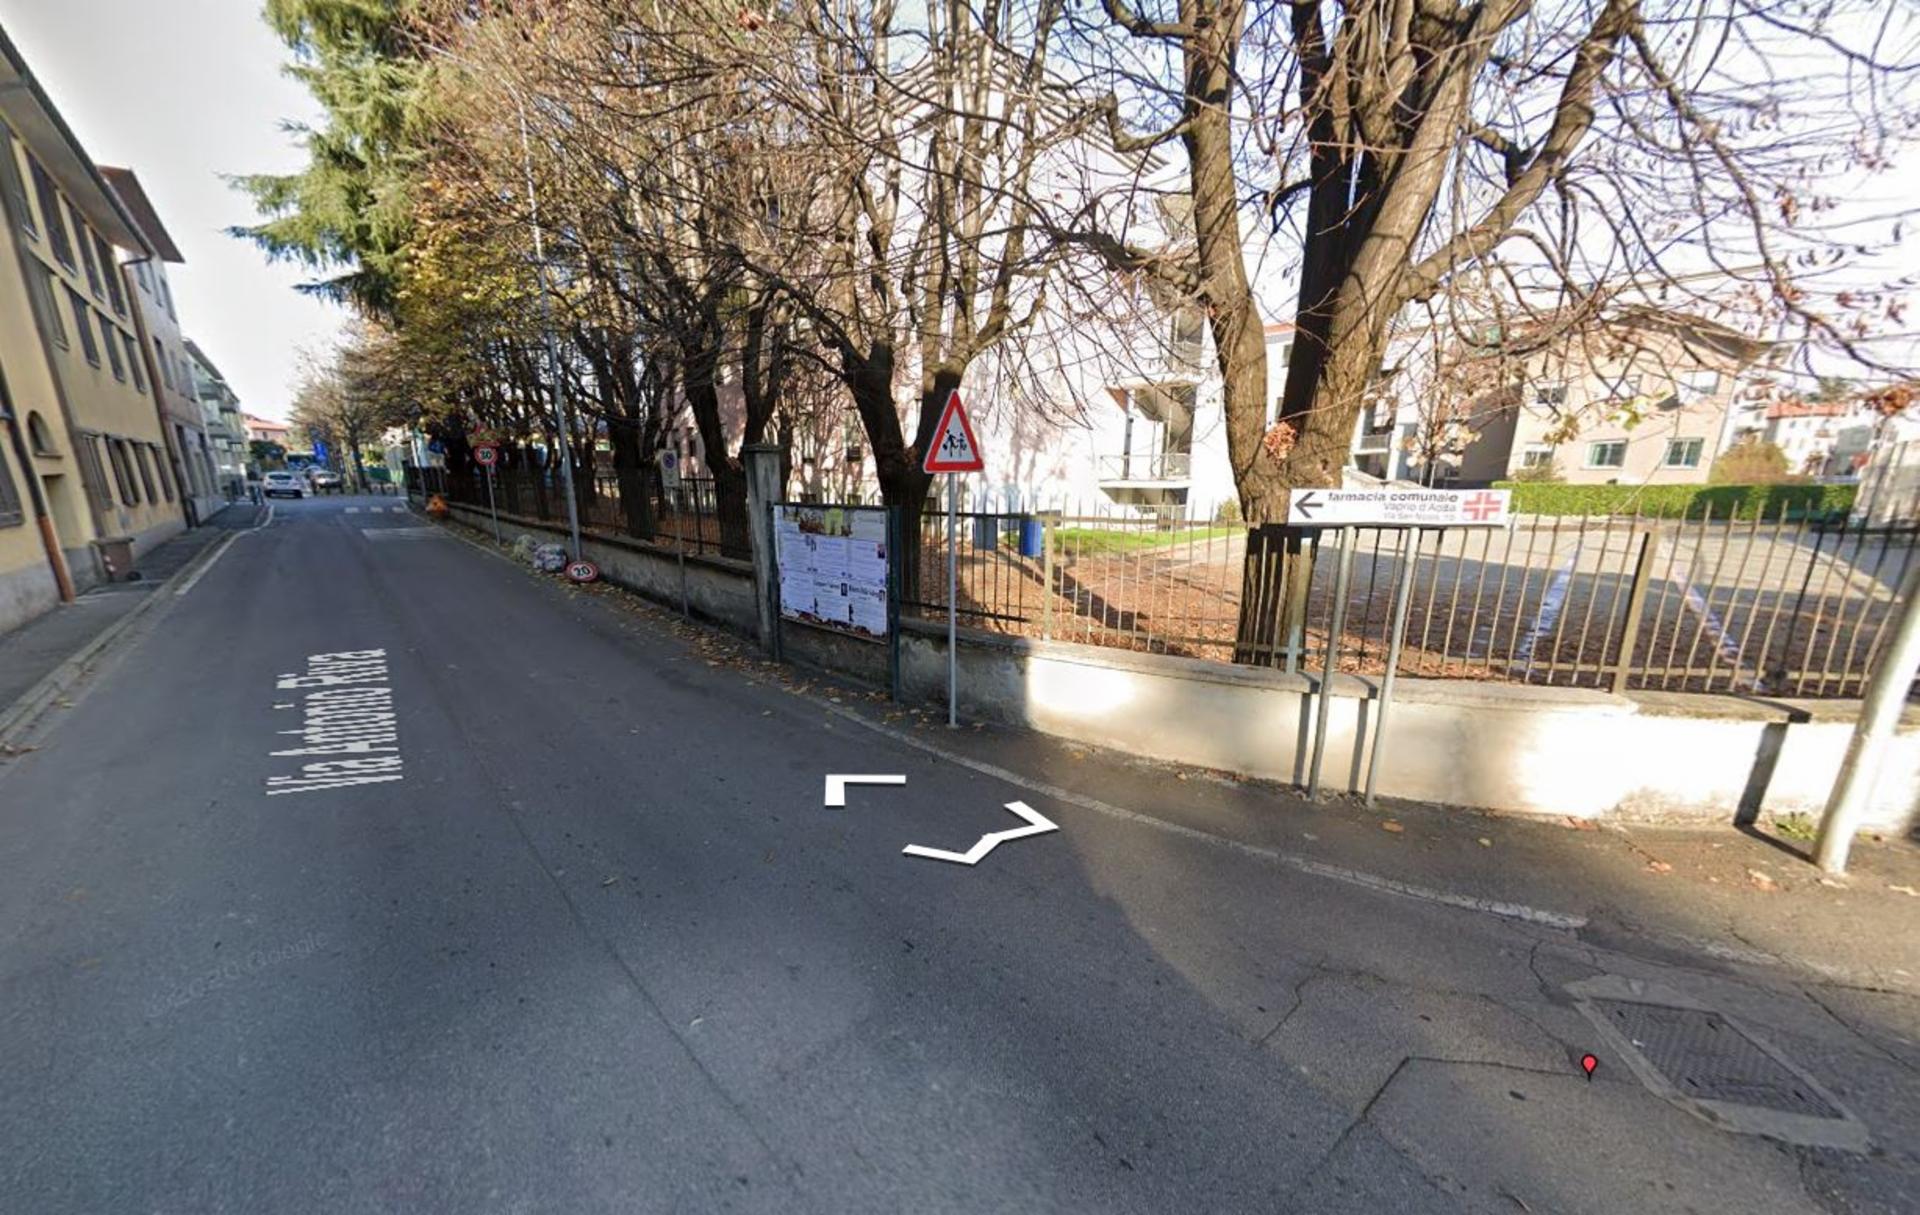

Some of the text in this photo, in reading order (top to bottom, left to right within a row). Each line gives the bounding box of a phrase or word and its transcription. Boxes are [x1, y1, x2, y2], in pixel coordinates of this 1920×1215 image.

[1328, 492, 1459, 503] farmacia comunale
[573, 565, 592, 577] 20
